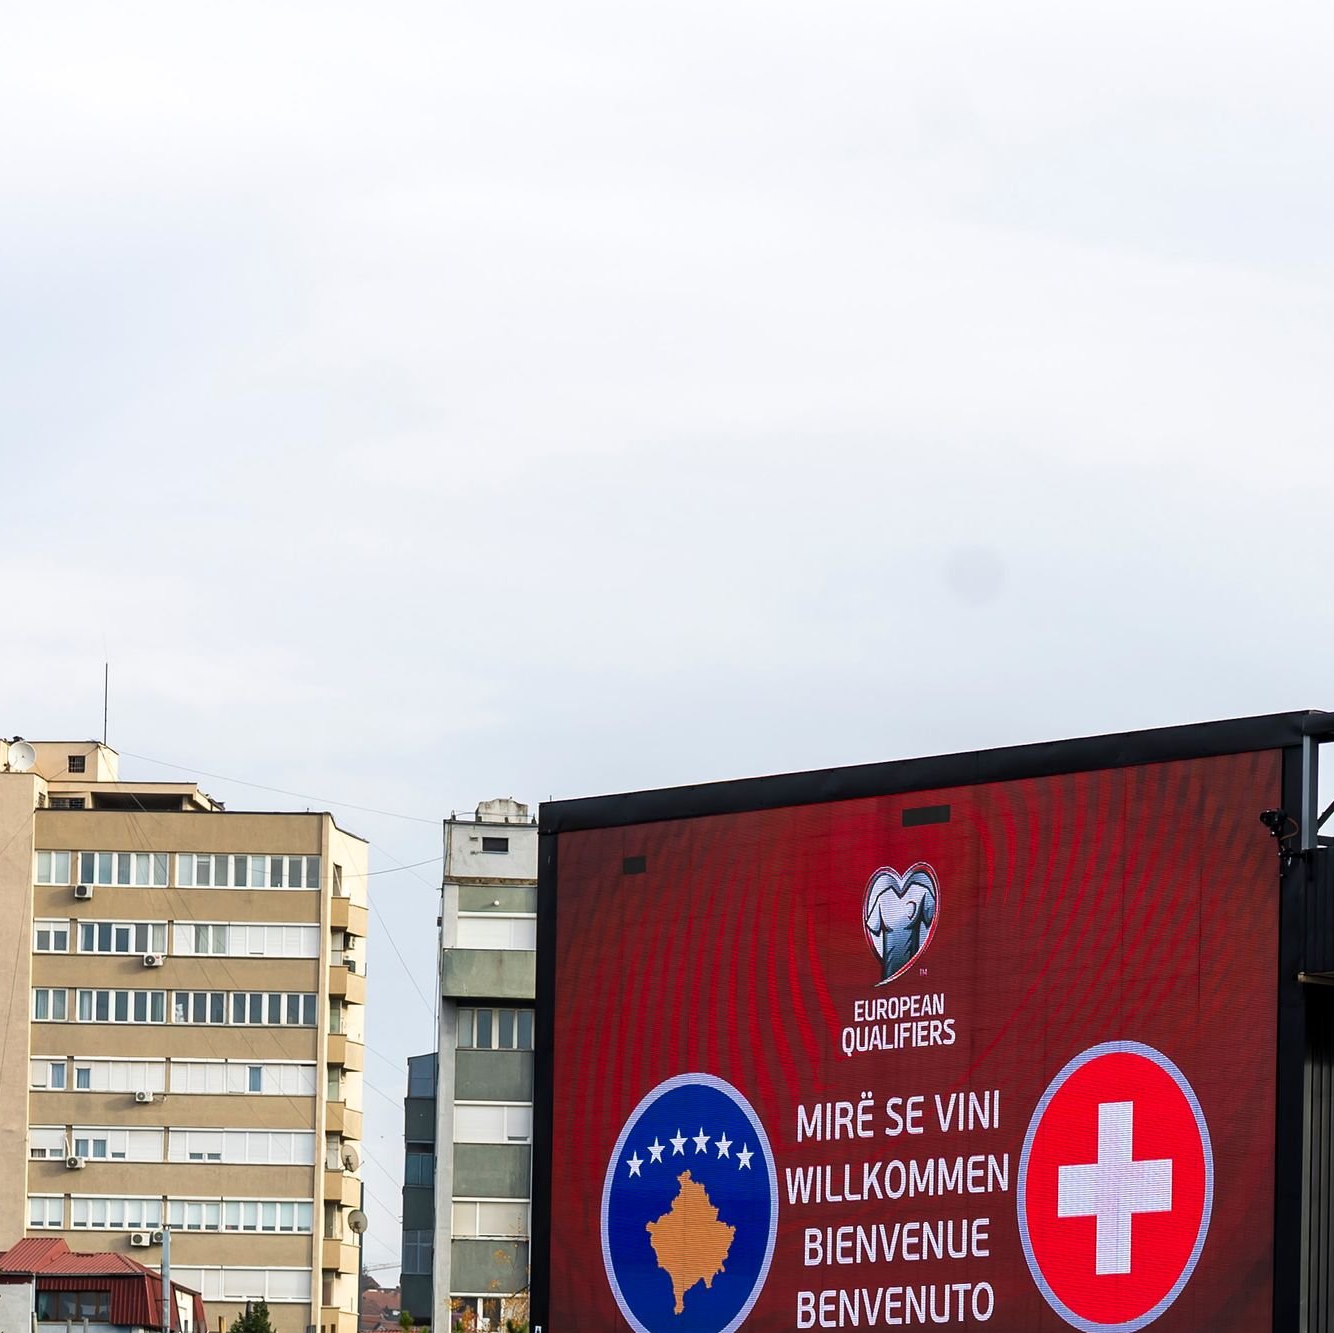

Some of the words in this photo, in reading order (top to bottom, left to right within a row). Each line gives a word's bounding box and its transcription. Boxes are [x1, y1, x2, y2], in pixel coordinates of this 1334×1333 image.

[854, 993, 945, 1022] EUROPEAN
[841, 1018, 956, 1057] QUALIFIERS
[797, 1091, 875, 1143] MIRË
[885, 1095, 925, 1137] SE
[934, 1089, 1000, 1133] VINI
[785, 1153, 1010, 1205] WILLKOMMEN
[803, 1218, 990, 1266] BIENVENUE
[796, 1281, 995, 1329] BENVENUTO
